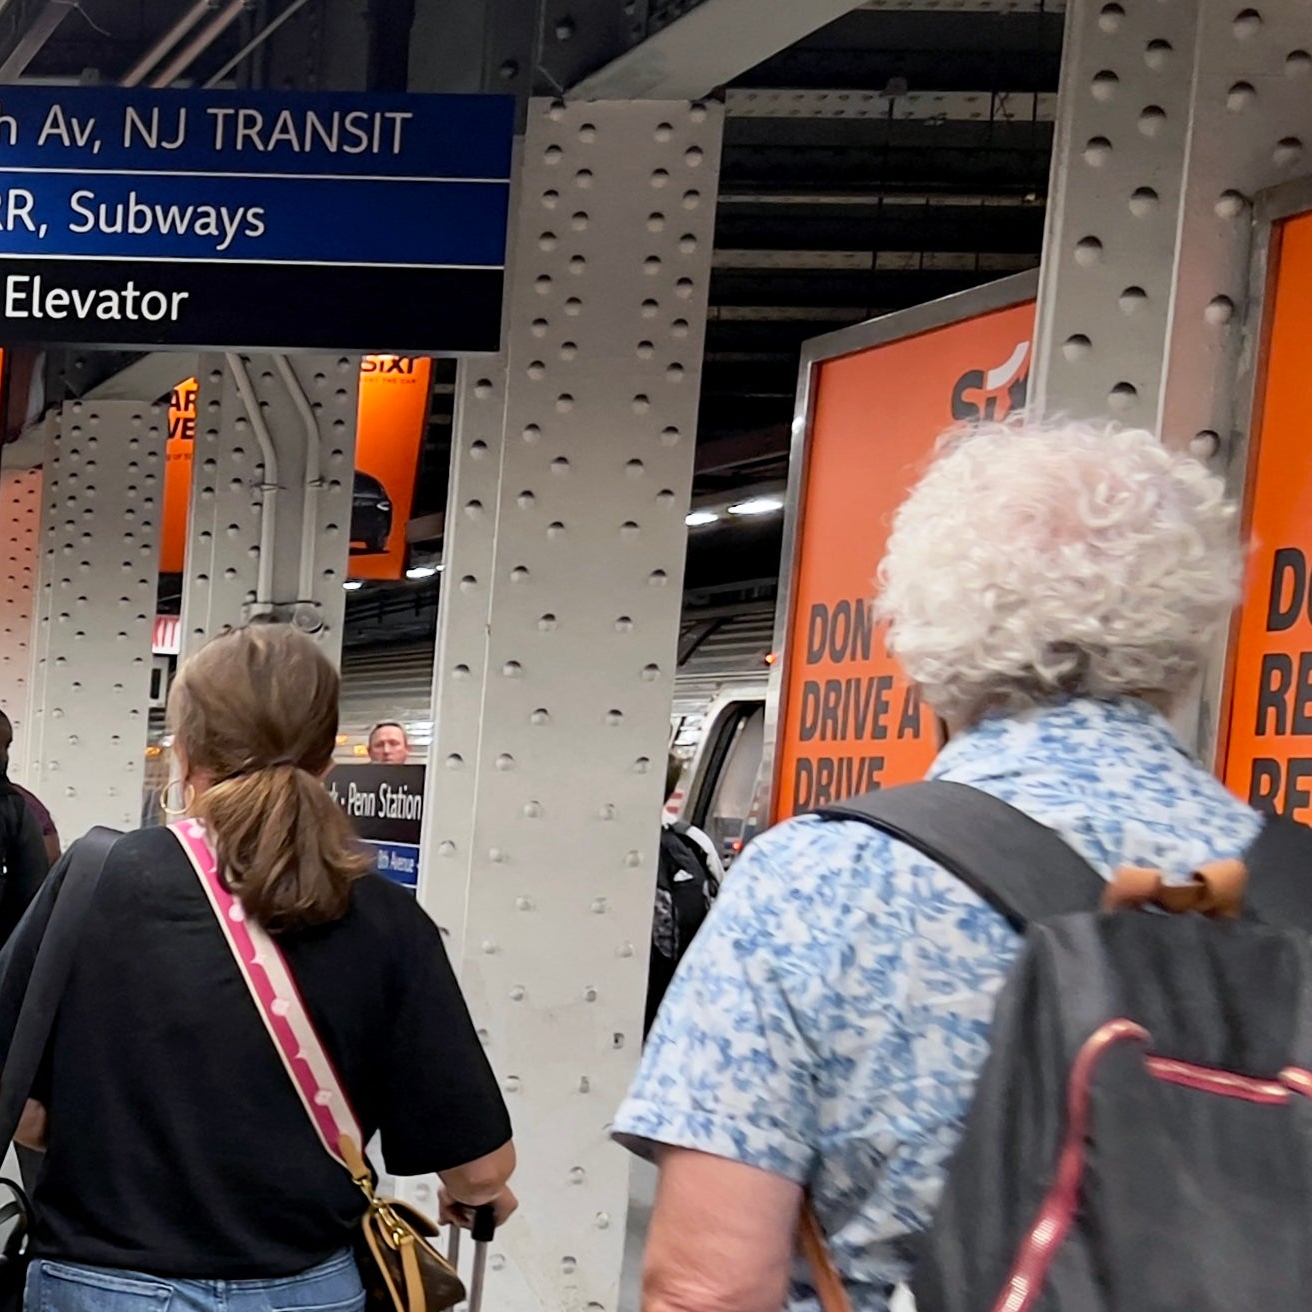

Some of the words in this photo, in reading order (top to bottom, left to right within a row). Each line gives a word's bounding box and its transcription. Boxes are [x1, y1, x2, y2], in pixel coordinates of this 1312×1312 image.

[37, 106, 103, 155] Av,
[123, 107, 186, 150] NJ
[207, 109, 413, 154] TRANSIT
[69, 190, 266, 250] Subways
[5, 275, 189, 321] Elevator
[807, 598, 885, 666] DON
[799, 675, 893, 742] DRIVE
[897, 684, 920, 740] A
[347, 782, 375, 816] Penn
[378, 783, 422, 820] Station
[792, 756, 885, 817] DRIVE
